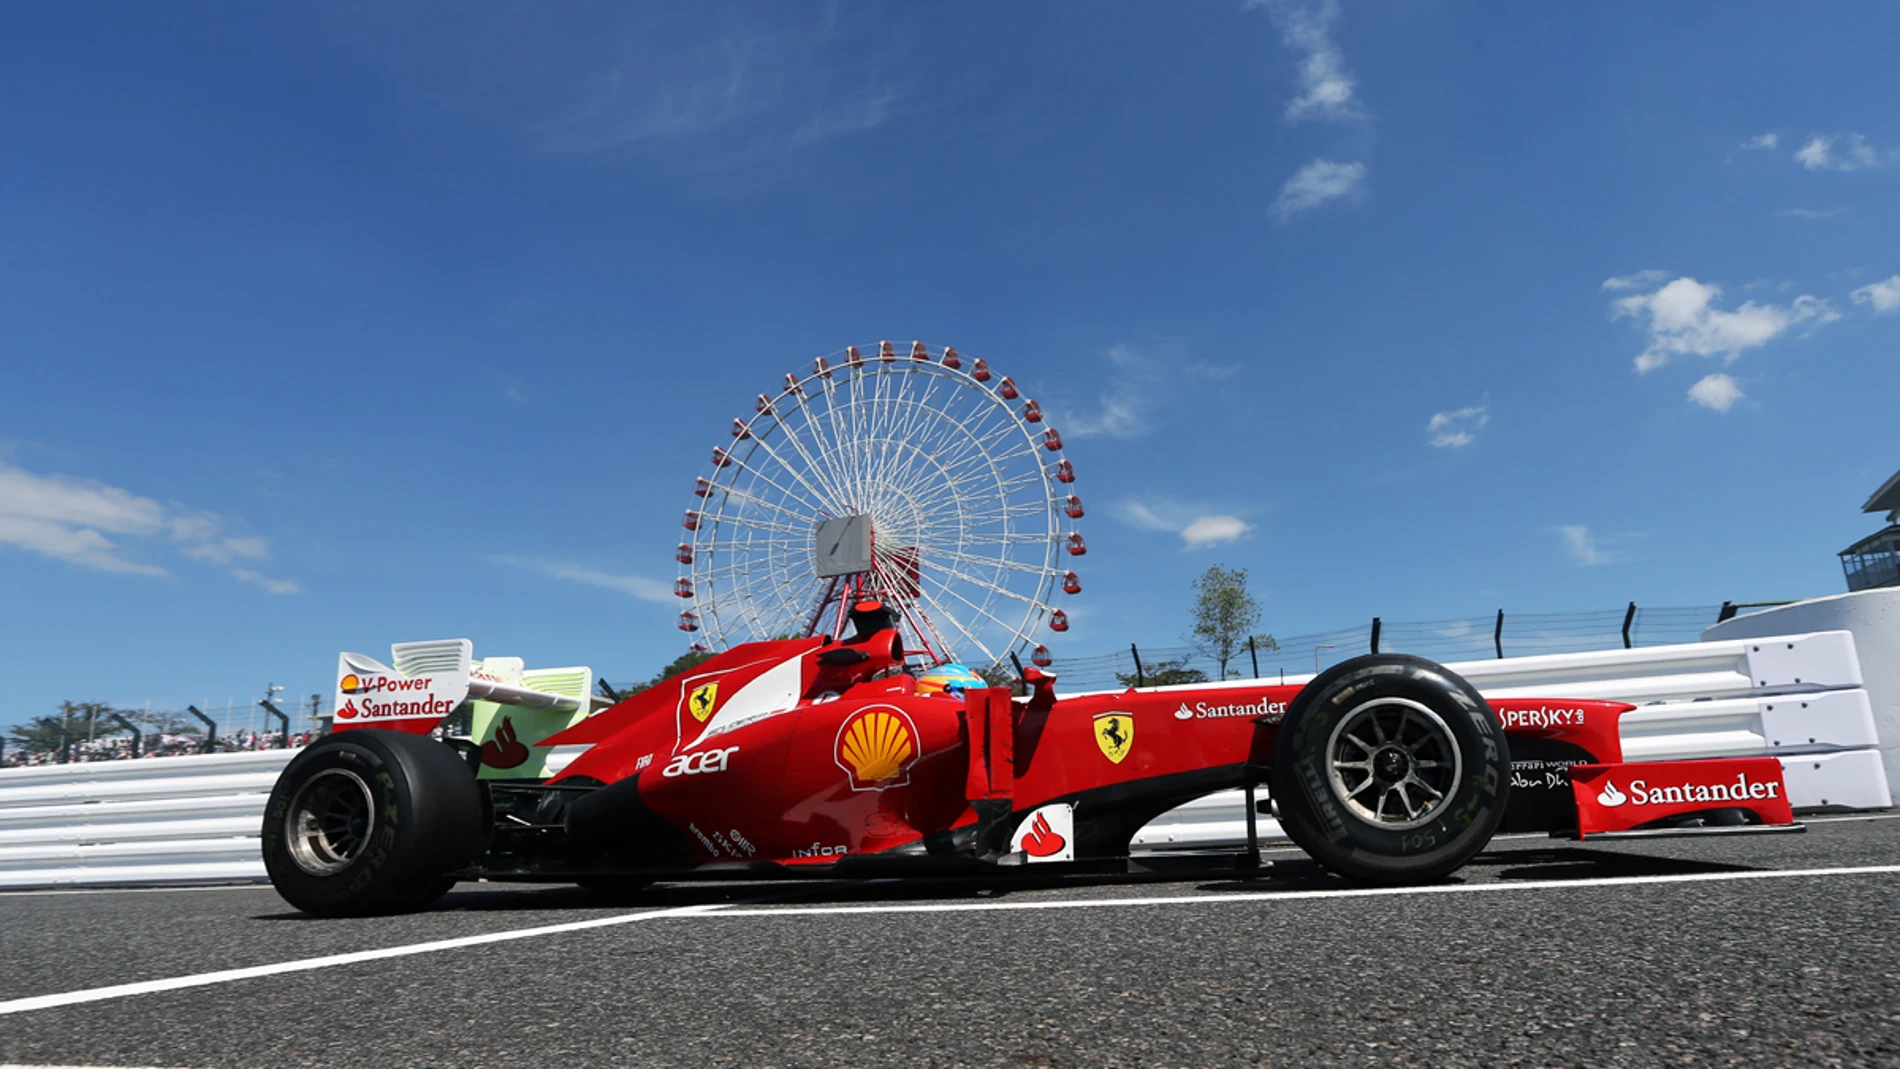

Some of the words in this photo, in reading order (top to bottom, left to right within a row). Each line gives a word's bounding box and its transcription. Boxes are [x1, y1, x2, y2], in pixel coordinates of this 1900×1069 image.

[362, 676, 432, 693] V-Power
[361, 693, 454, 718] Santander
[1196, 697, 1286, 719] Santander
[1499, 706, 1574, 730] SPERSKY
[1448, 689, 1499, 798] ZERO
[662, 746, 740, 778] acer
[1629, 772, 1780, 806] Santander
